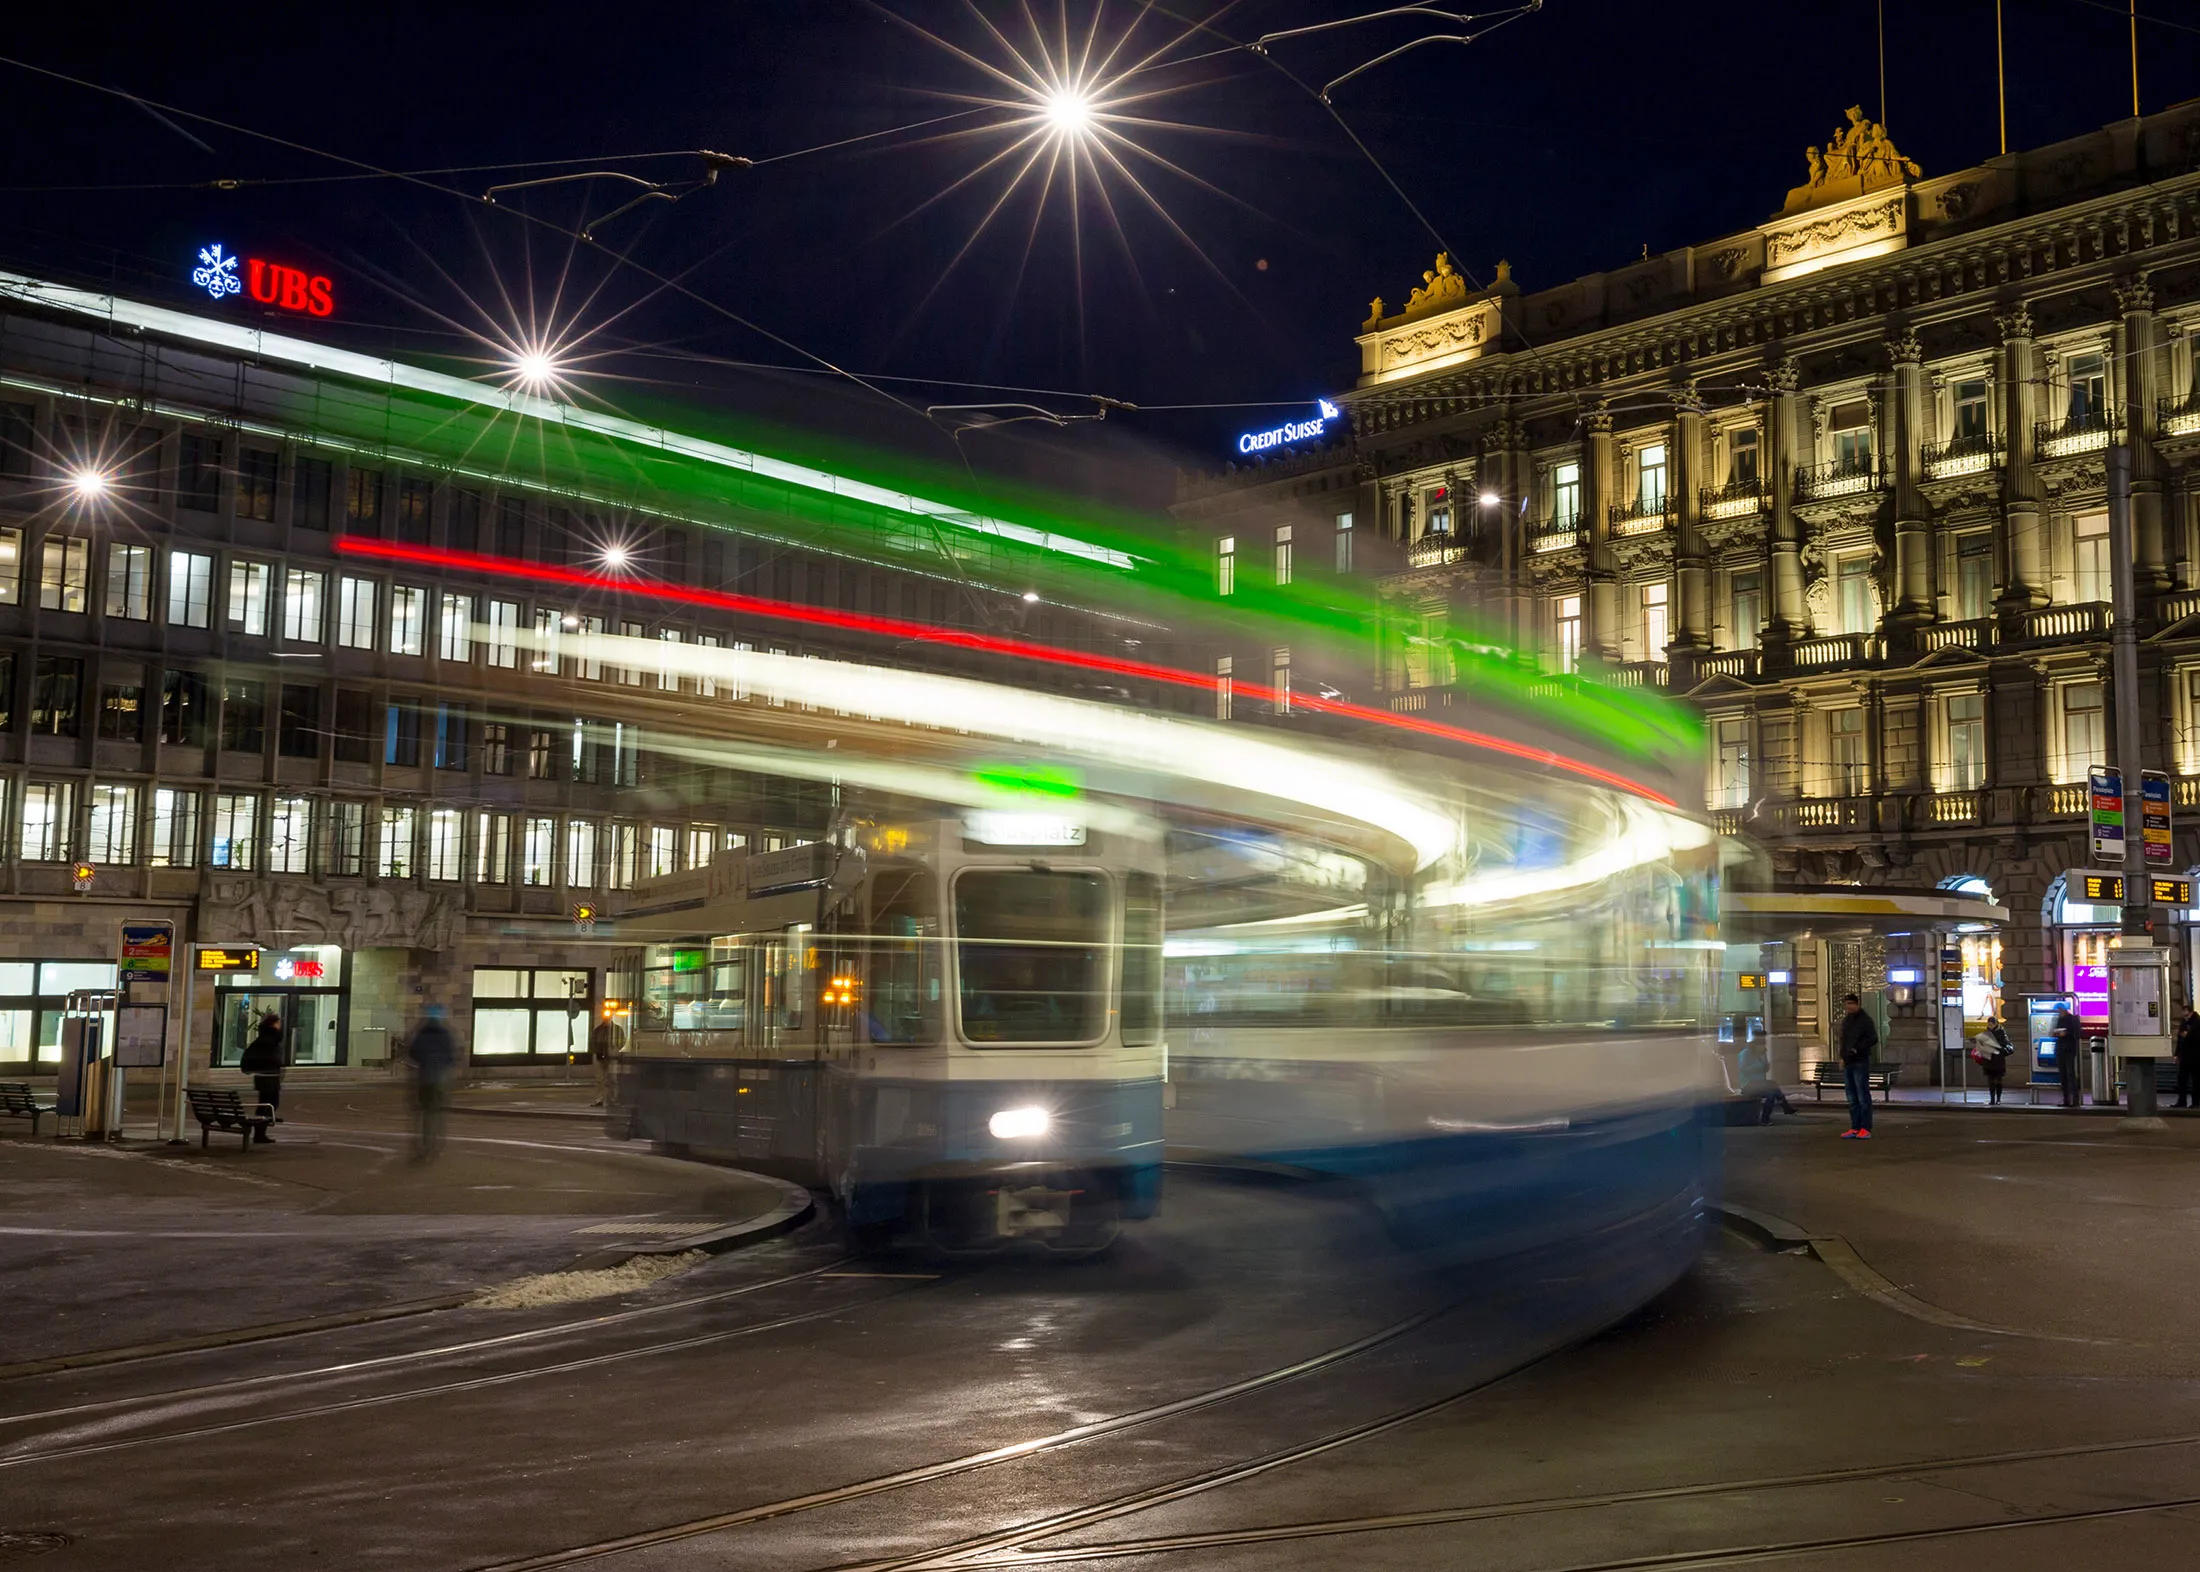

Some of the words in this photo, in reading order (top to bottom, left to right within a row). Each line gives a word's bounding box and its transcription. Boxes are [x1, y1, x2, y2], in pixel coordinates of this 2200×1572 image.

[249, 258, 334, 317] UBS
[1239, 428, 1284, 453] CREDIT
[1284, 418, 1324, 442] SUISSE
[80, 882, 86, 890] 8
[581, 924, 587, 933] 8
